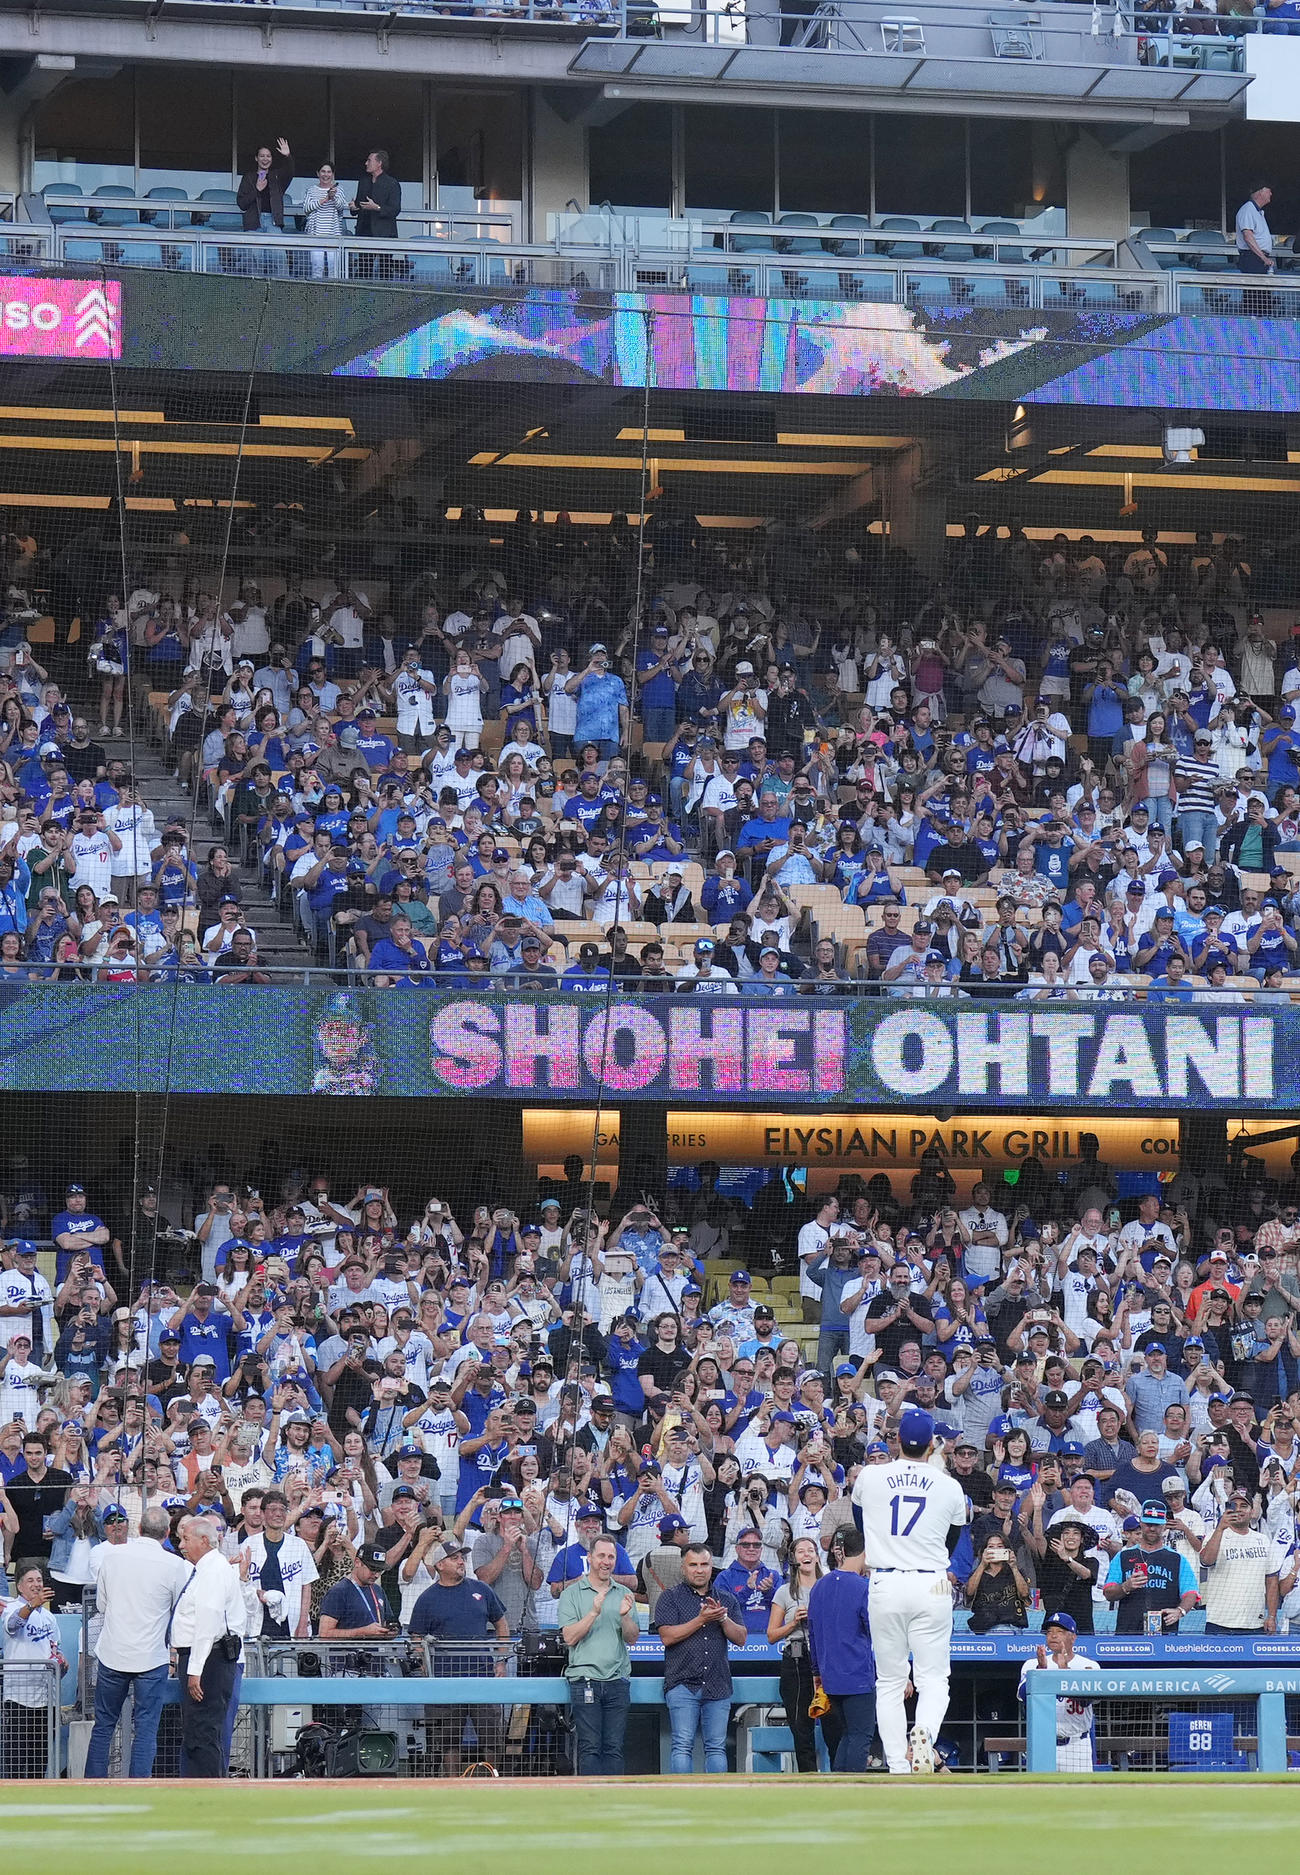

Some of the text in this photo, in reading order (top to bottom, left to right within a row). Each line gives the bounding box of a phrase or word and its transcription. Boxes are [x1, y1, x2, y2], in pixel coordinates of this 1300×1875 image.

[99, 853, 107, 862] 17
[448, 867, 455, 877] 3
[1116, 939, 1126, 956] LA
[431, 1000, 1274, 1098] SHOHEI OHTANI
[765, 1127, 897, 1159] ELYSIAN
[910, 1128, 993, 1159] PARK
[68, 1220, 94, 1232] Dodgers
[771, 1250, 783, 1264] LA
[955, 1326, 972, 1343] LA
[176, 1372, 184, 1384] LA
[448, 1434, 458, 1447] 17
[407, 1444, 417, 1454] D
[225, 1476, 236, 1486] LOS
[887, 1474, 934, 1491] OHTANI
[588, 1489, 597, 1500] LA
[889, 1495, 927, 1536] 17
[1226, 1547, 1267, 1560] LOS ANGELES
[1053, 1611, 1060, 1622] LA
[728, 1642, 768, 1651] dca.com
[1165, 1643, 1244, 1652] blueshieldca.com
[1060, 1680, 1201, 1692] BANK OF AMERICA
[1266, 1680, 1300, 1692] BAN
[1189, 1720, 1212, 1731] GEREN
[1189, 1733, 1212, 1750] 88
